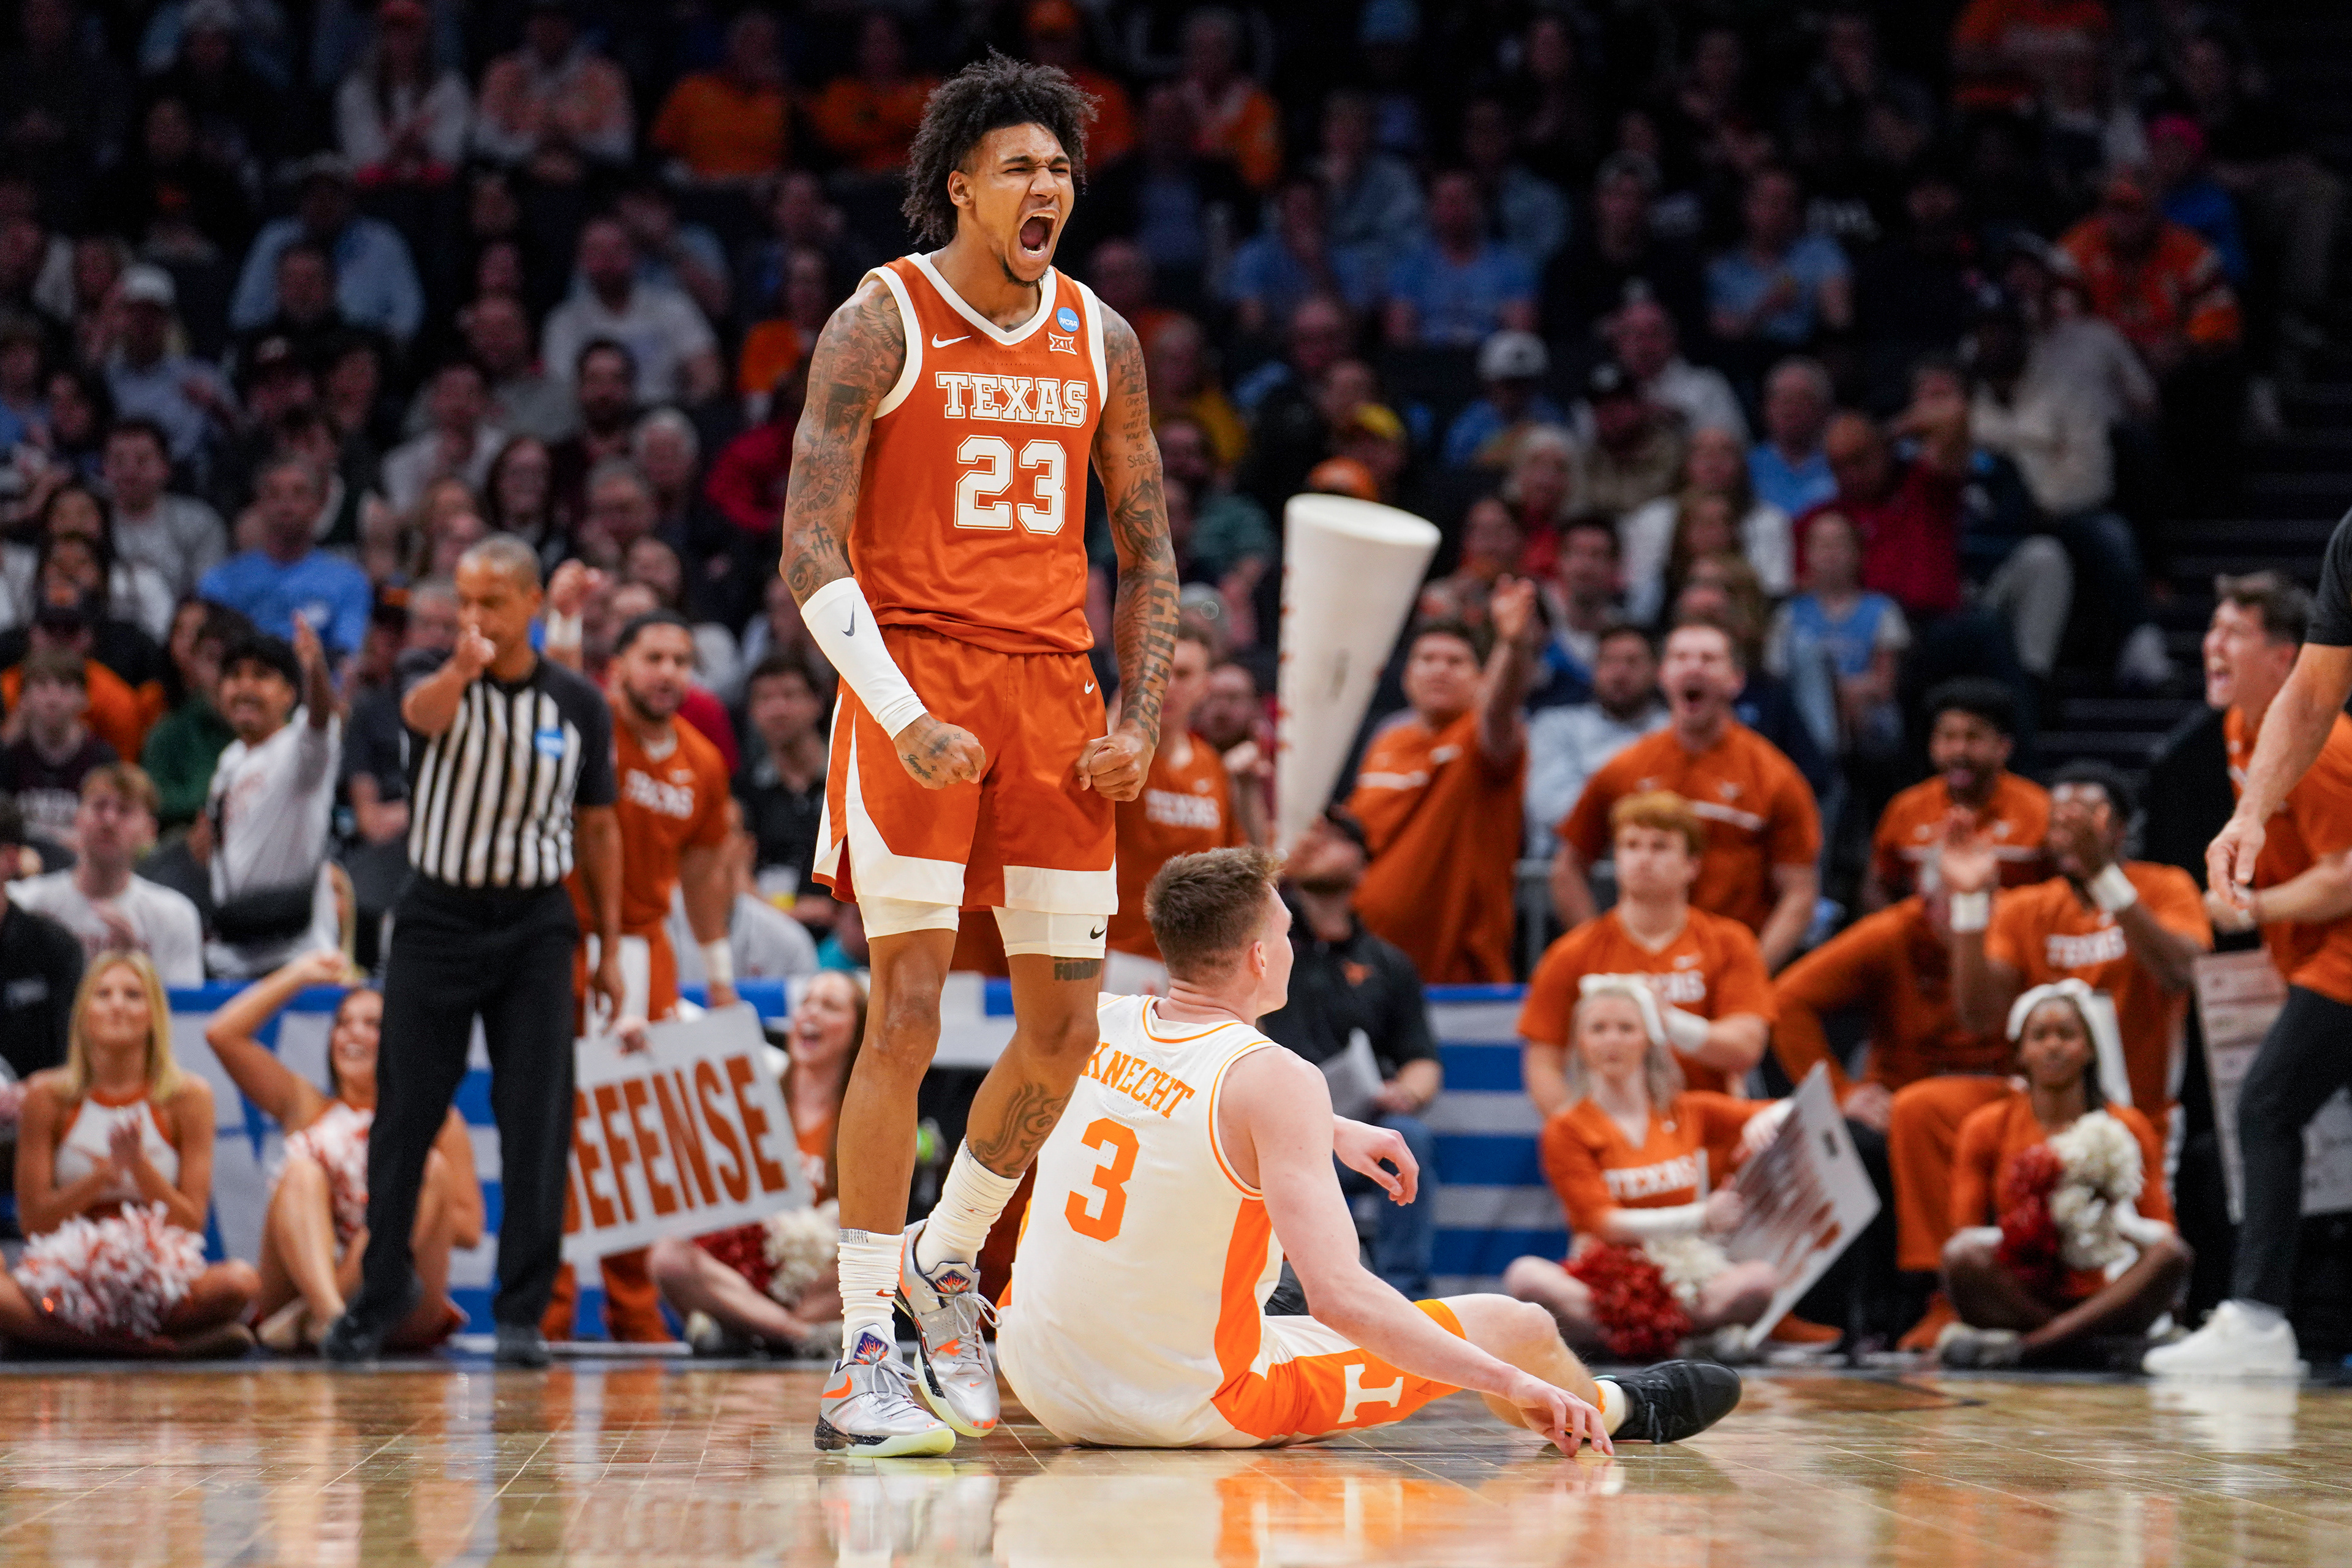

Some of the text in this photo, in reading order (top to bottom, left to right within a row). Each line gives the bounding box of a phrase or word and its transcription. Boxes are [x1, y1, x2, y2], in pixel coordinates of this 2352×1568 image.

[1060, 317, 1078, 327] NCAA
[936, 372, 1088, 428] TEXAS
[954, 435, 1066, 535] 23
[2045, 926, 2127, 968] TEXAS
[1080, 1042, 1195, 1120] KNECHT
[1065, 1118, 1139, 1242] 3
[1602, 1155, 1699, 1202] TEXAS
[1338, 1363, 1404, 1423] T
